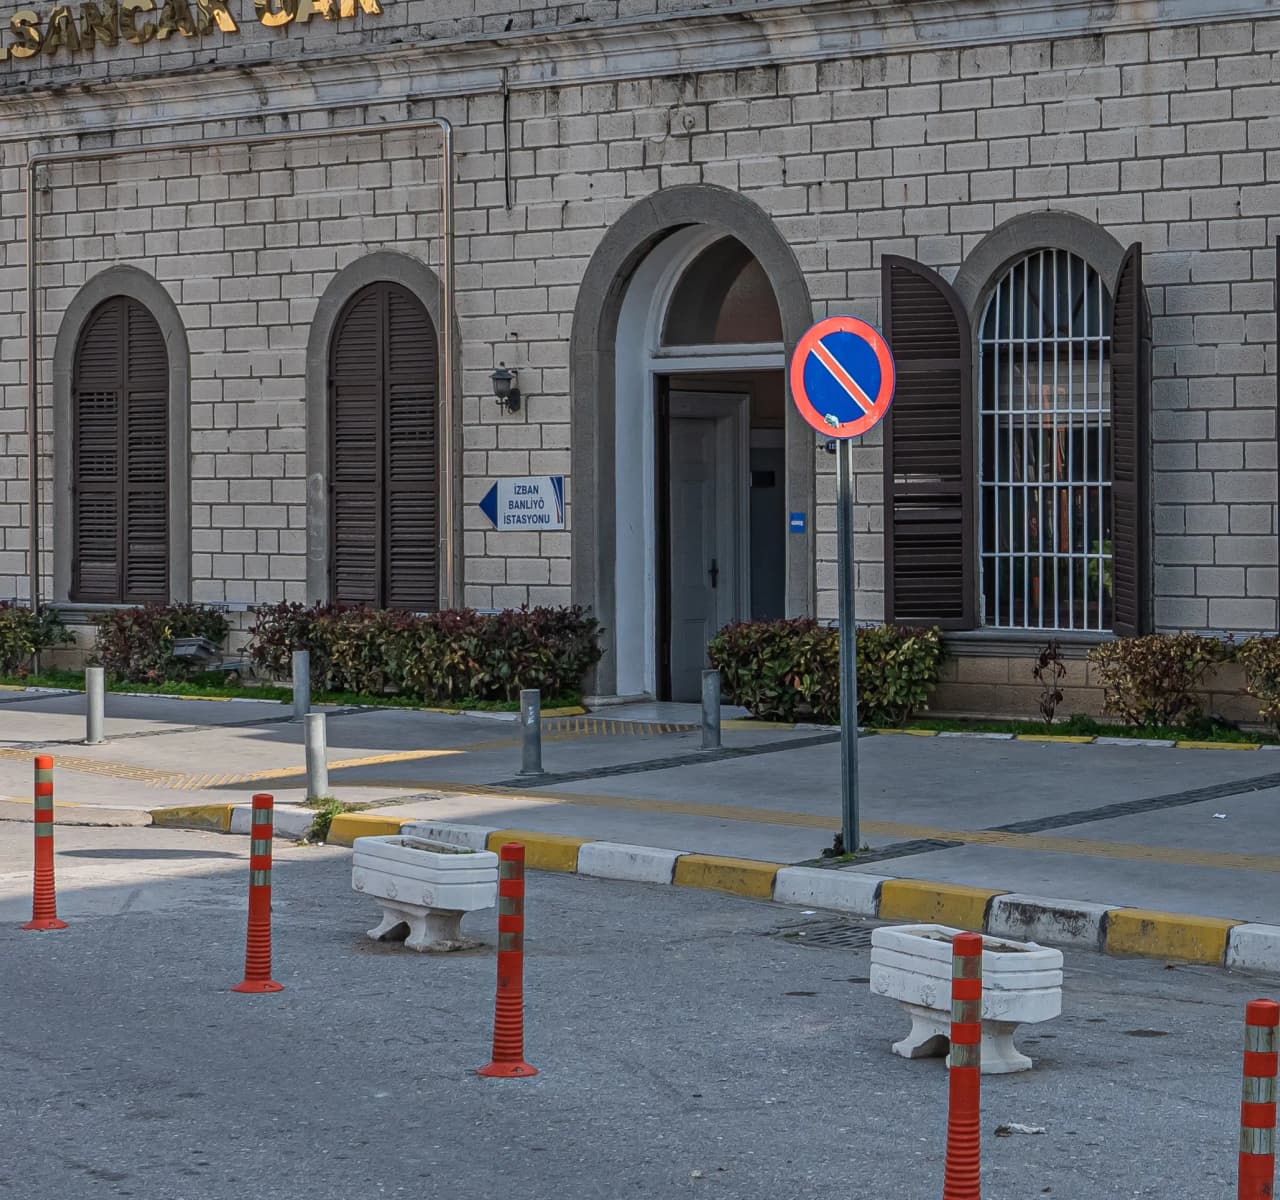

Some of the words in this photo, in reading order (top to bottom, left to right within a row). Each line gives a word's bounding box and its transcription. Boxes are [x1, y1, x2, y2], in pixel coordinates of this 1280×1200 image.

[513, 483, 539, 495] İZBAN
[508, 497, 545, 510] BANLİYÖ
[503, 512, 550, 525] İSTASYONU
